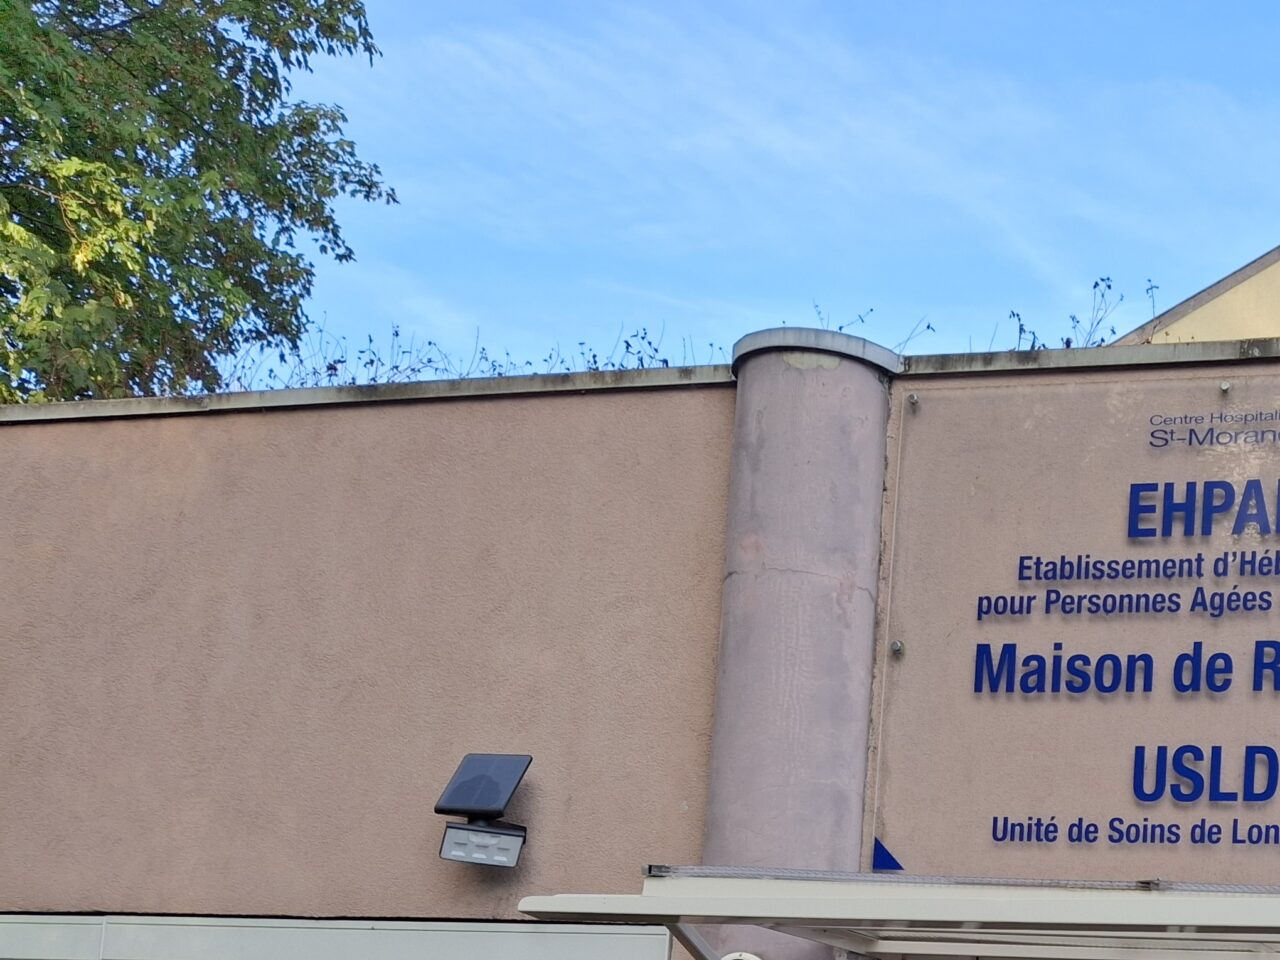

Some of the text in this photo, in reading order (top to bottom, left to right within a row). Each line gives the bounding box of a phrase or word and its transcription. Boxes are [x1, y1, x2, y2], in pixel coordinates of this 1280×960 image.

[1149, 414, 1205, 427] Centre
[1019, 555, 1204, 581] Etablissement
[978, 597, 1036, 619] pour
[1045, 590, 1181, 614] Personnes
[1190, 587, 1273, 616] Agées
[973, 643, 1154, 694] Maison
[1172, 641, 1233, 693] de
[1132, 745, 1280, 804] USLD
[991, 816, 1059, 843] Unité
[1068, 819, 1099, 843] de
[1108, 818, 1180, 844] Soins
[1190, 820, 1222, 843] de
